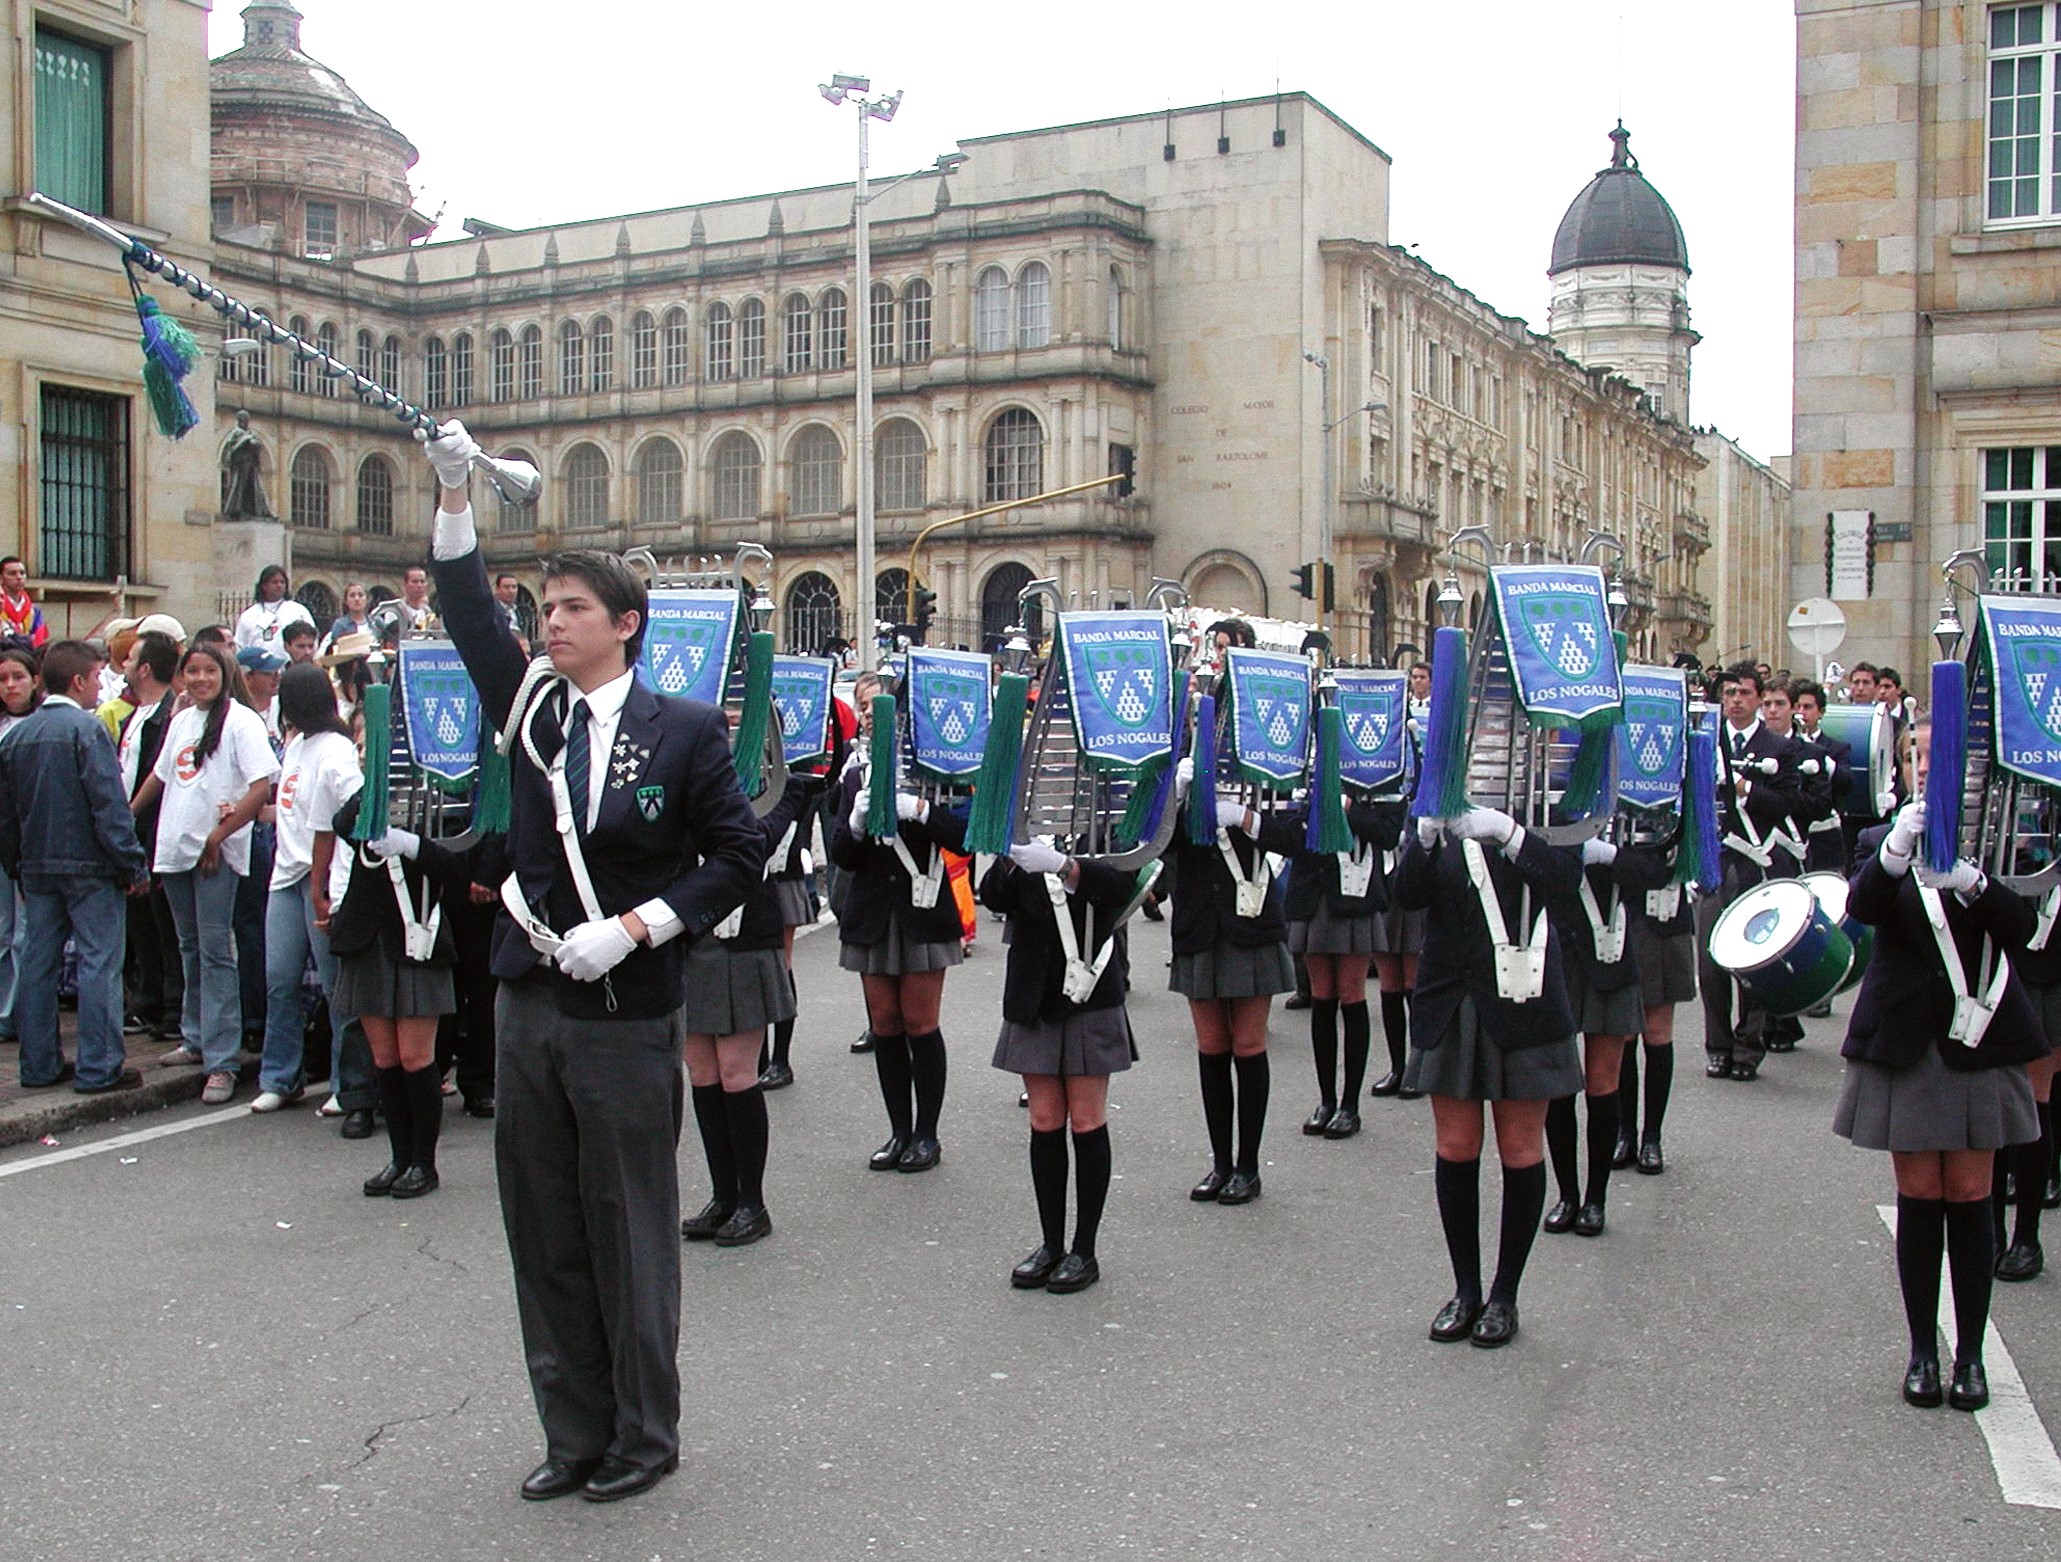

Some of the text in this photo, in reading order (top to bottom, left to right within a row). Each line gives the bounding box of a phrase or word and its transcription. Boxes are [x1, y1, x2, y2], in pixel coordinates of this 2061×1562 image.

[1243, 400, 1275, 409] MAYOR
[1177, 455, 1194, 463] SAN
[1507, 582, 1599, 596] BANDA MARCIAL
[648, 608, 726, 621] BANDA MARCIAL
[1998, 623, 2041, 637] BANDA
[1073, 630, 1160, 643] BANDA MARCIAL
[409, 661, 435, 671] BANDA
[917, 664, 946, 674] BANDA
[948, 667, 985, 680] MARCIAL
[791, 671, 825, 681] MARCIAL
[1238, 665, 1307, 682] BANDA MARCIAL
[1338, 684, 1399, 693] ANDA MARCIAL
[1529, 685, 1618, 703] LOS NOGALES
[1625, 686, 1681, 700] NDA MARCIAL
[784, 742, 818, 750] OGALES
[1088, 732, 1172, 748] LOS NOGALES
[422, 753, 439, 762] LOS
[917, 749, 937, 758] LOS
[1245, 750, 1266, 760] LOS
[2012, 750, 2043, 764] LOS
[1339, 760, 1397, 769] LOS NOGALES
[1620, 780, 1679, 792] OS NOGALES
